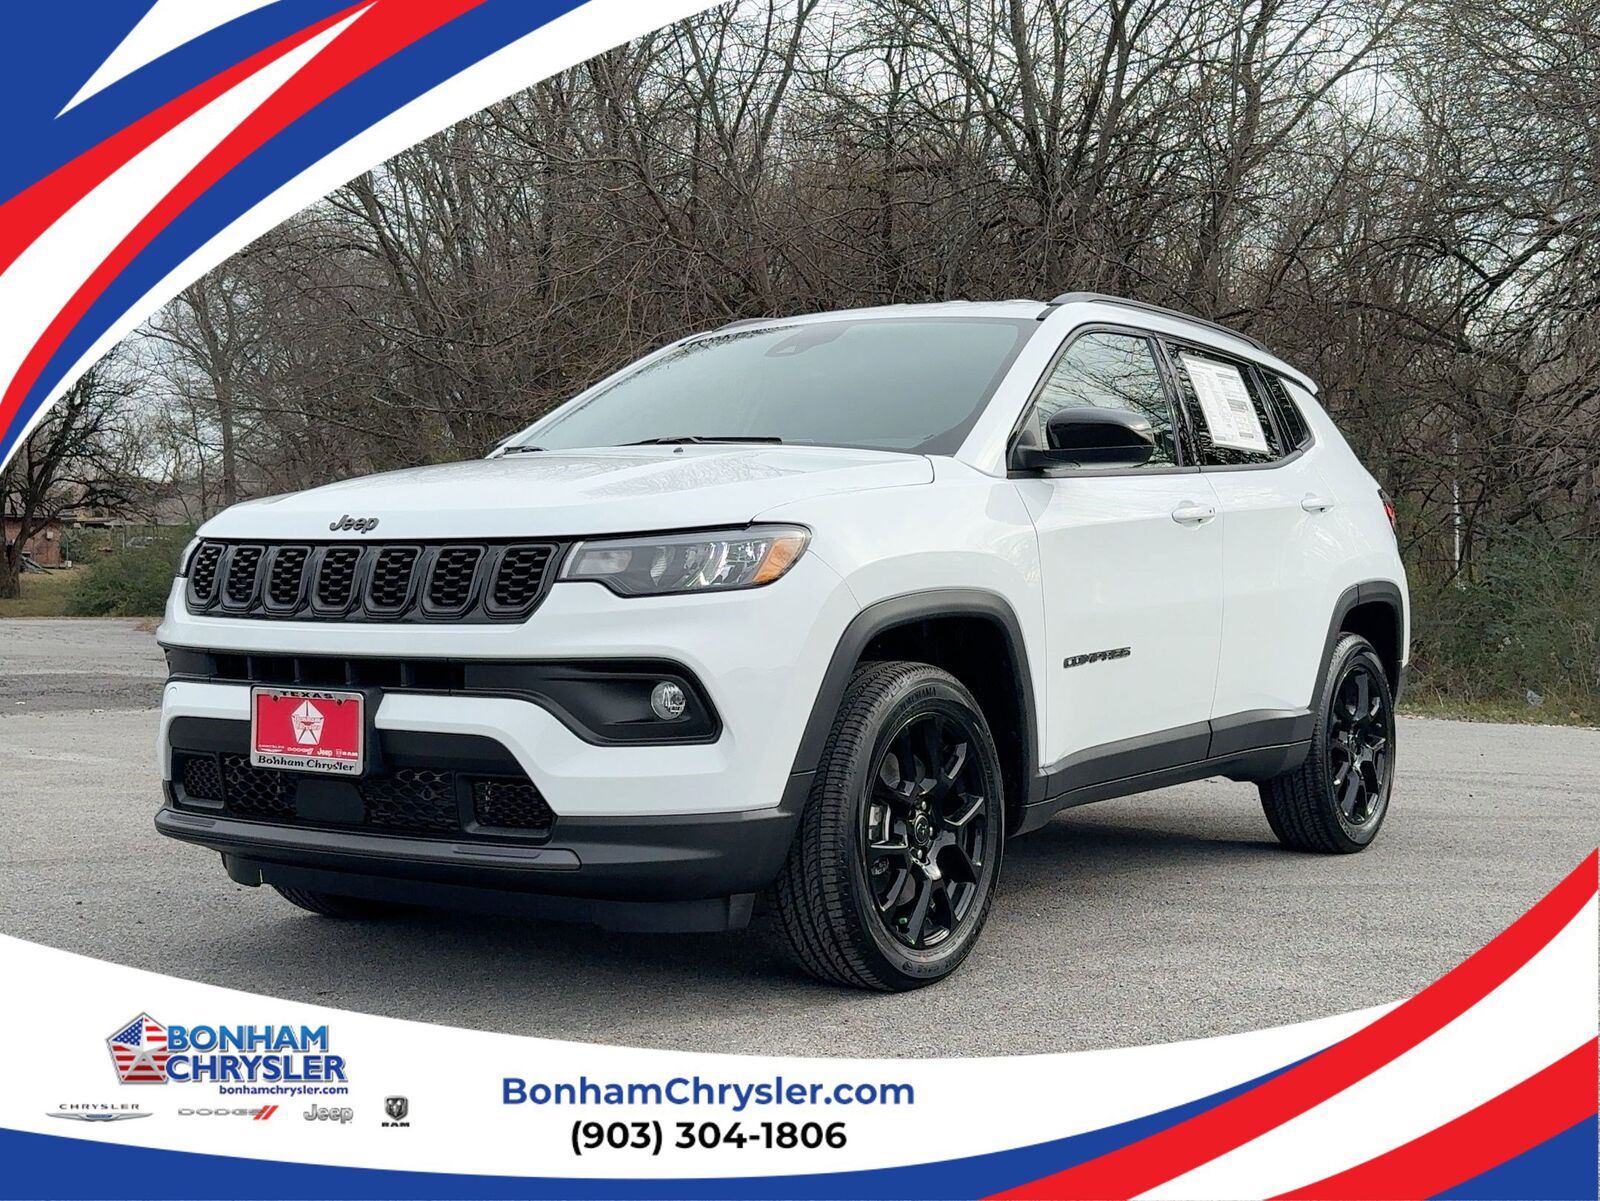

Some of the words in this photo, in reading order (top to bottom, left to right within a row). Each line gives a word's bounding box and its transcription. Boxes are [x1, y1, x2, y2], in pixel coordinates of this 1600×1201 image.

[329, 514, 380, 534] Jeep
[280, 690, 334, 699] TEXAS
[258, 755, 304, 768] Bonham
[306, 759, 355, 773] Chrysler
